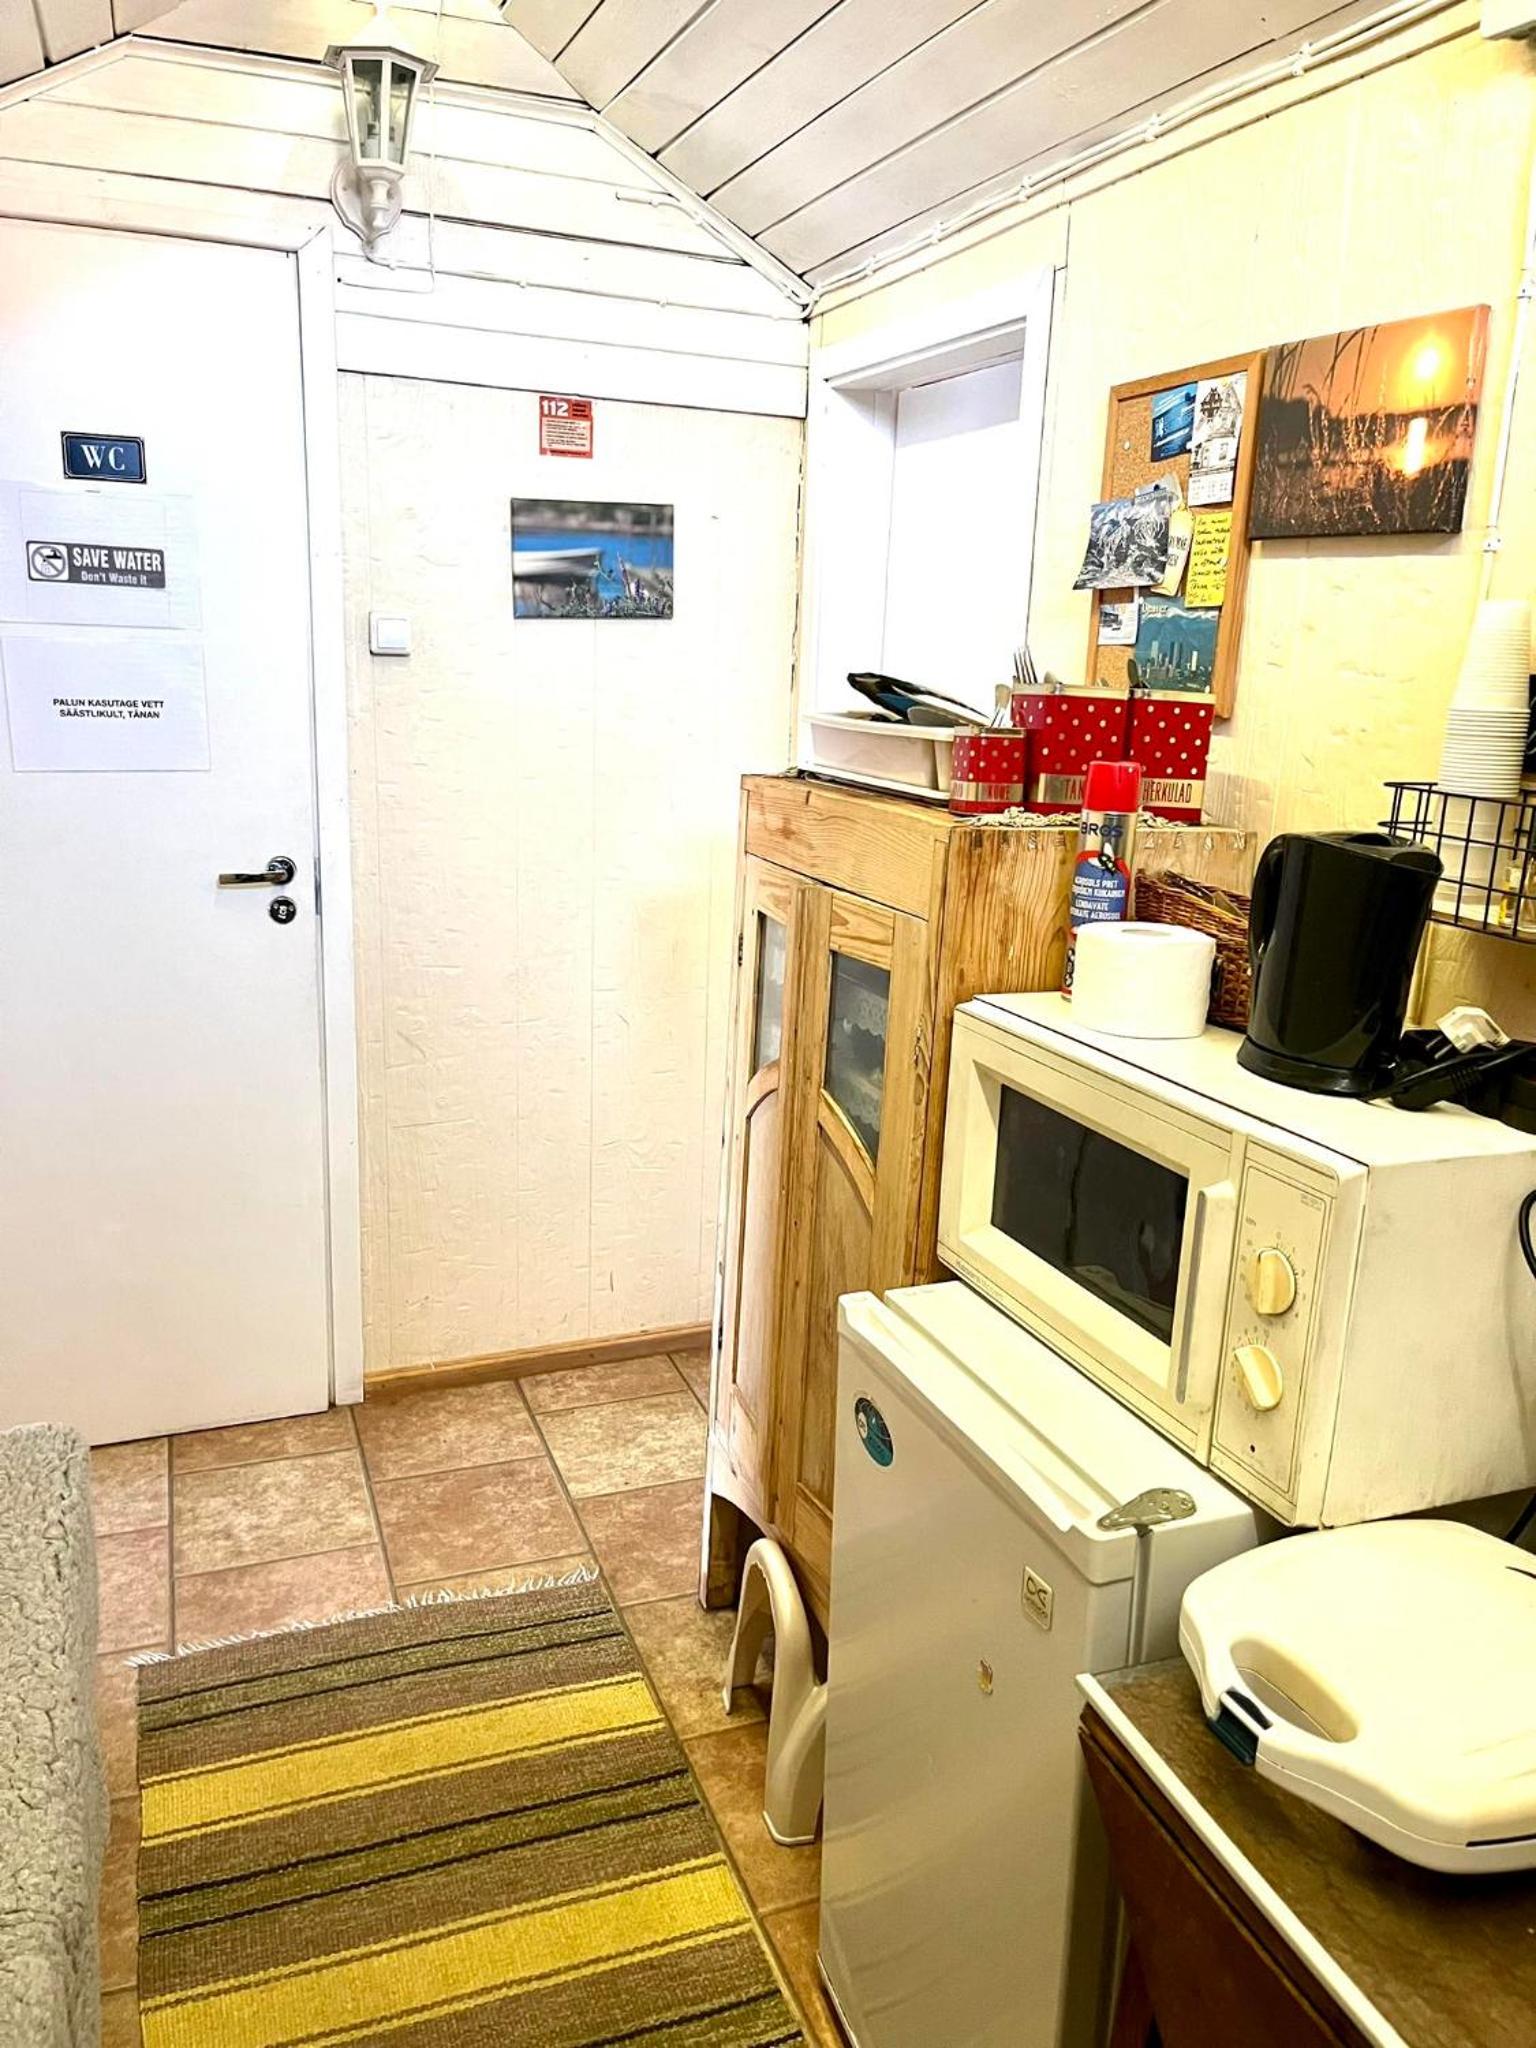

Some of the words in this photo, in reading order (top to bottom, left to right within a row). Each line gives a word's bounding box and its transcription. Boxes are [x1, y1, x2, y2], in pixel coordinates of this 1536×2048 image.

[542, 400, 569, 416] 112
[80, 444, 125, 471] WC
[73, 546, 109, 569] SAVE
[113, 550, 162, 572] WATER
[81, 570, 106, 582] Don't
[109, 572, 138, 584] Waste
[53, 698, 86, 707] PALUN
[88, 699, 138, 708] KASUTAGE
[141, 700, 164, 709] VETT
[59, 708, 126, 720] SÄÄSTLIKULT,
[127, 709, 160, 719] TÄNAN
[1080, 821, 1124, 837] BROS
